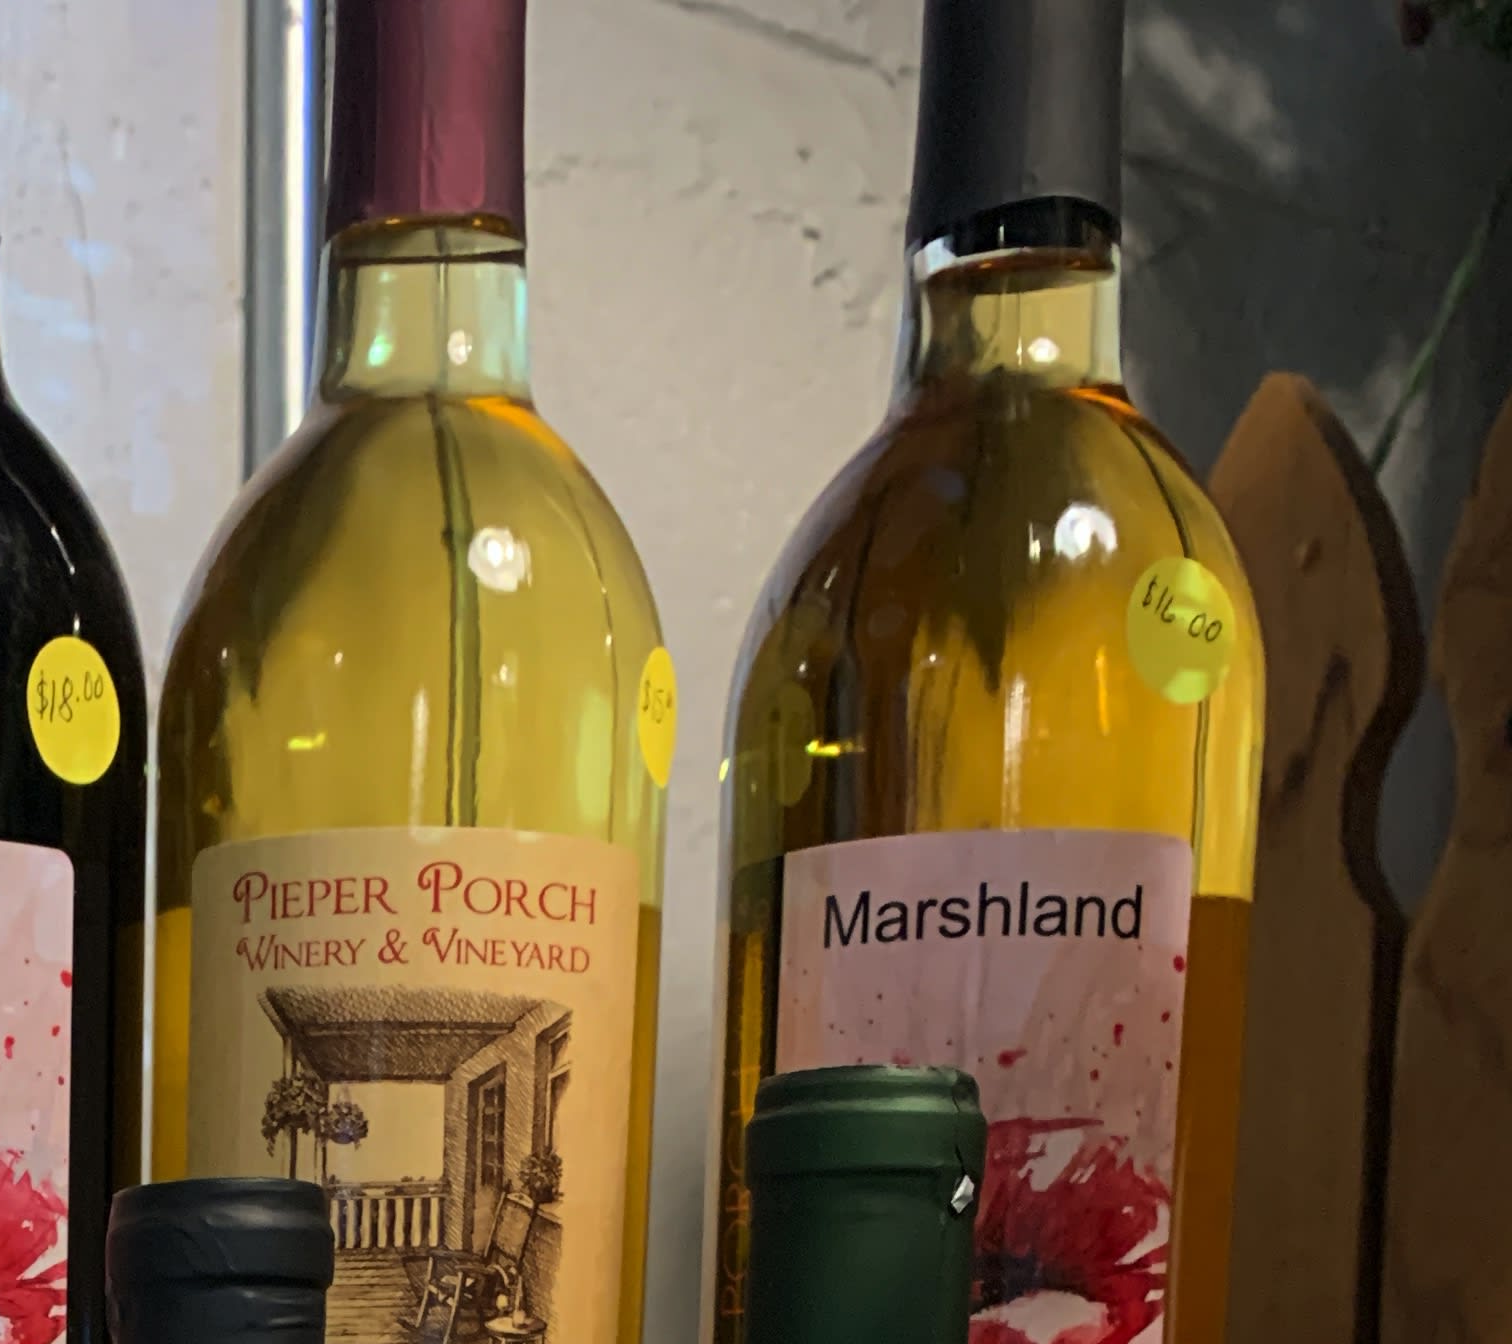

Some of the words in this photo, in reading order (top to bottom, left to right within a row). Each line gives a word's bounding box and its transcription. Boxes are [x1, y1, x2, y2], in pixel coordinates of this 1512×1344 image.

[36, 669, 104, 724] $18.00
[232, 871, 397, 925] PIEPER
[417, 861, 598, 925] PORCH
[823, 882, 1144, 949] Marshland
[236, 934, 367, 972] WINERY
[377, 928, 409, 965] &
[422, 927, 591, 974] VINEYARD
